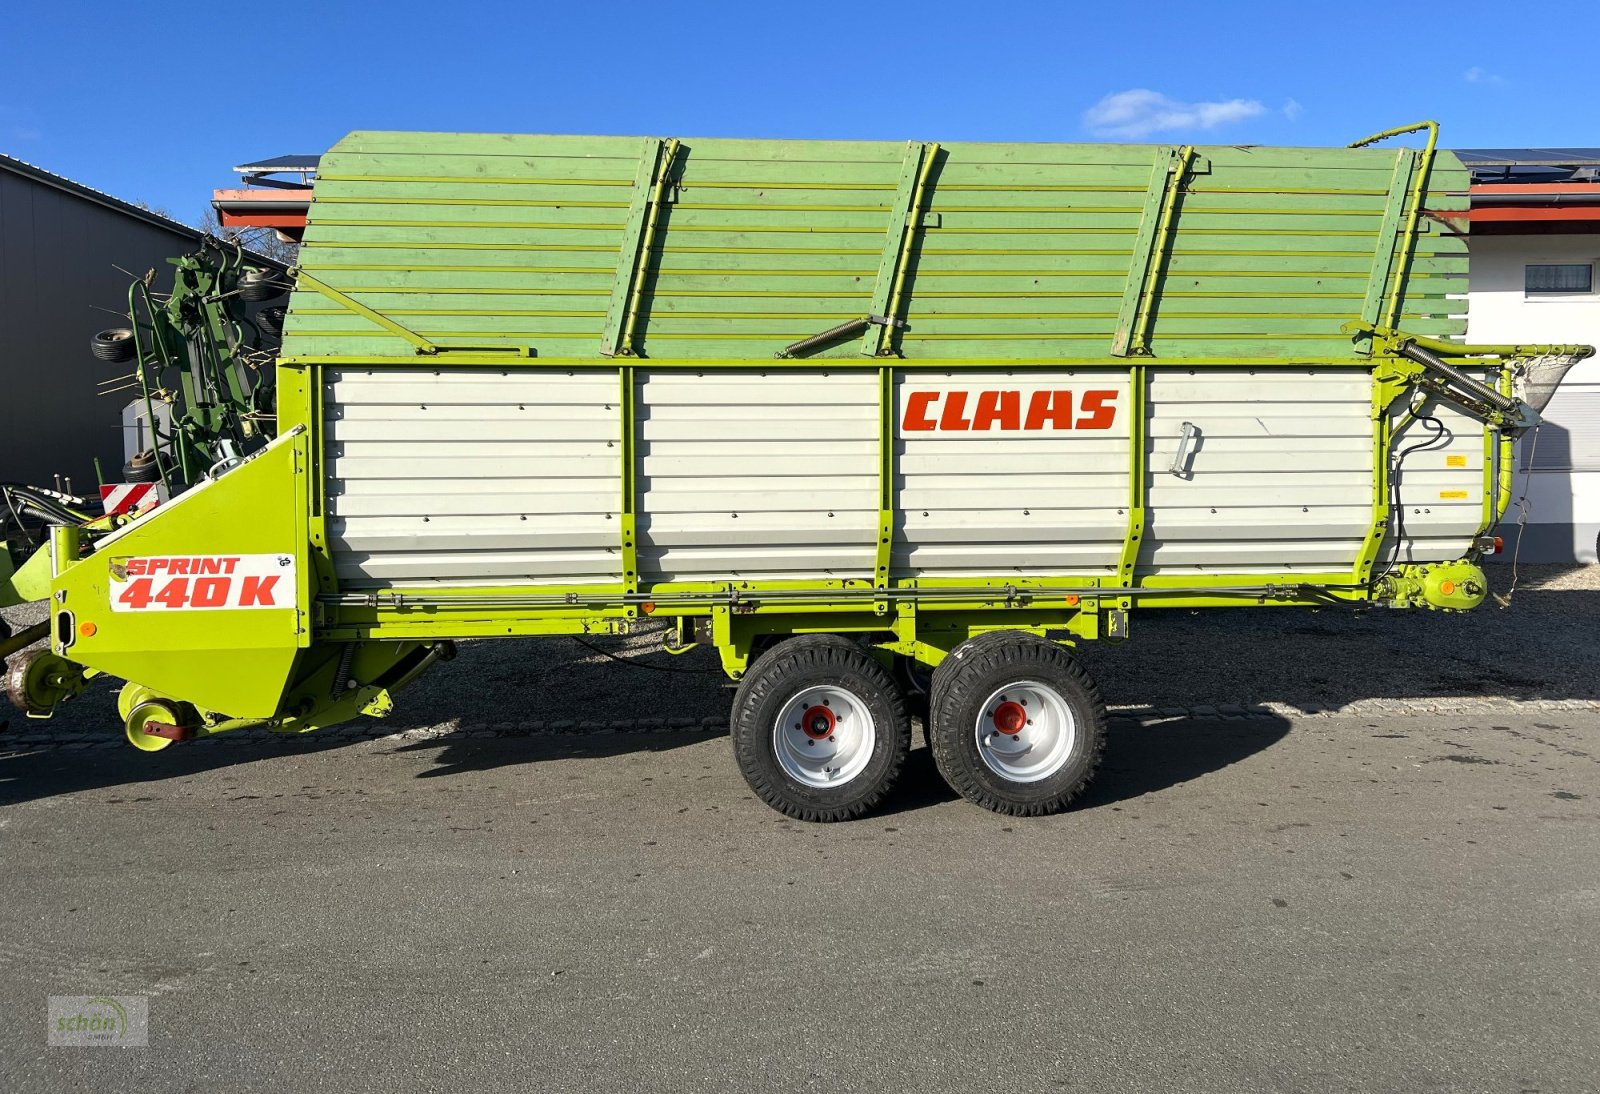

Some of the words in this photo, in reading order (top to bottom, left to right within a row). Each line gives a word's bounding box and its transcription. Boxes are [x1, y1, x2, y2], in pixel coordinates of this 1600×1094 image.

[902, 390, 1119, 431] CLAAS
[127, 558, 240, 575] SPRINT
[119, 577, 231, 608] 440
[238, 576, 281, 606] K
